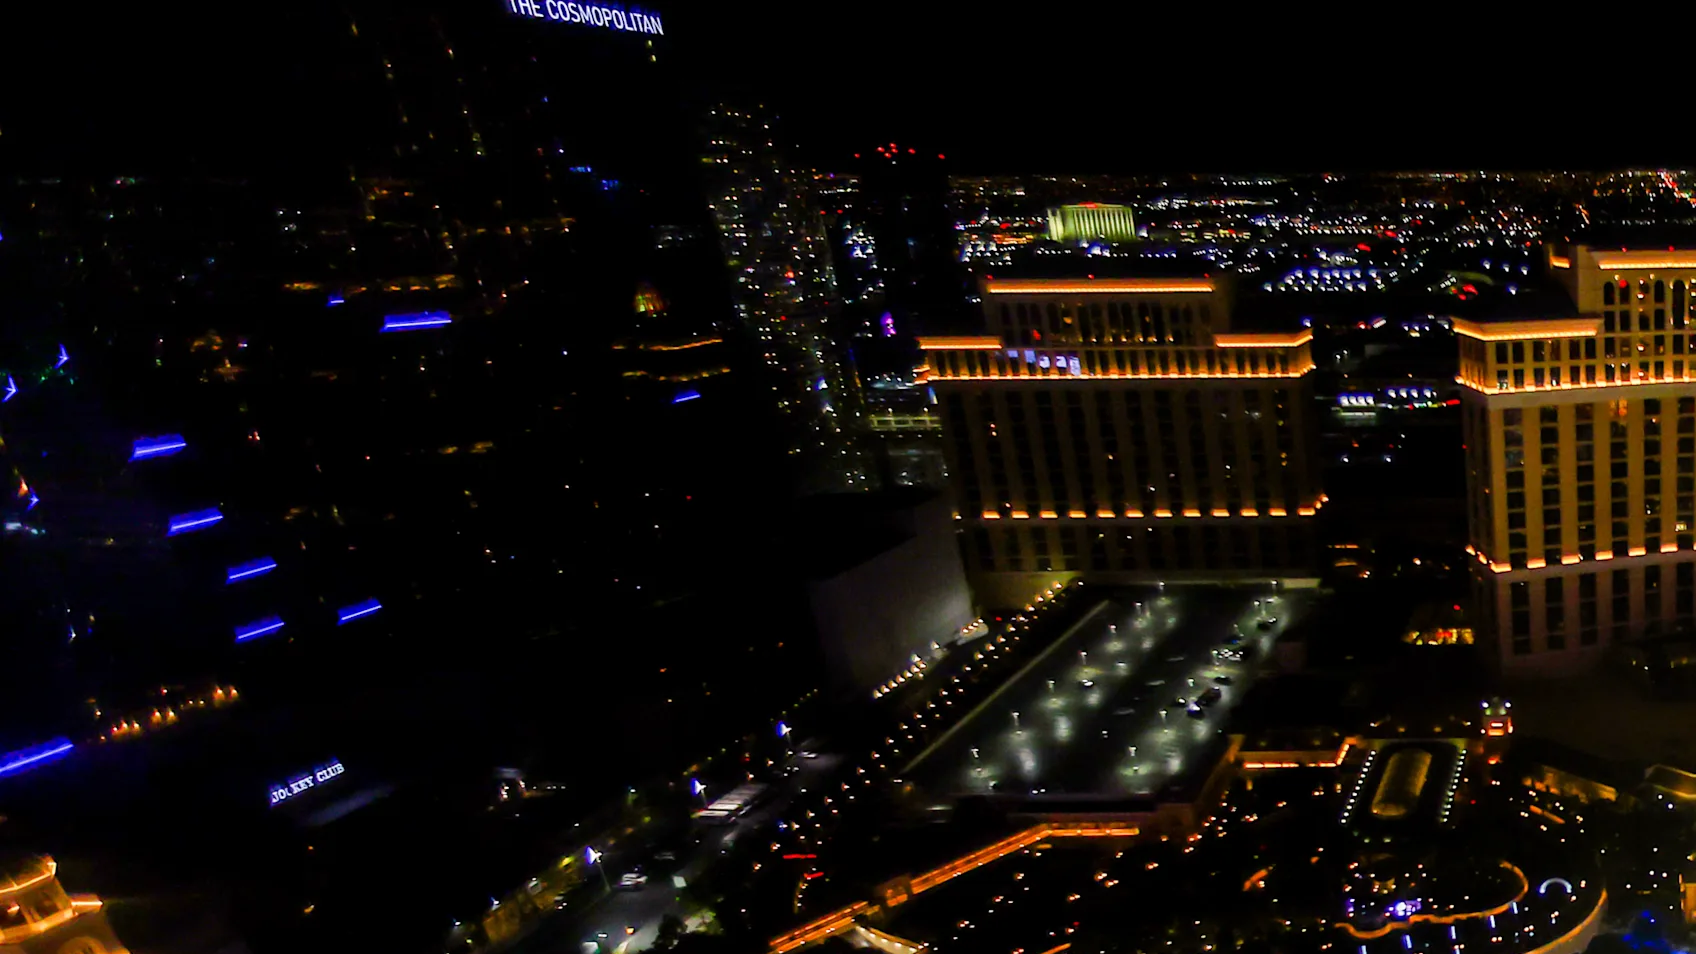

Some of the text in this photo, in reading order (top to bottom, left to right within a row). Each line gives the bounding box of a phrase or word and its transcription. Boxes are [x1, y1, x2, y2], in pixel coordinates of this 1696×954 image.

[510, 0, 665, 36] THE COSMOPOLITAN
[316, 763, 345, 782] CLUB
